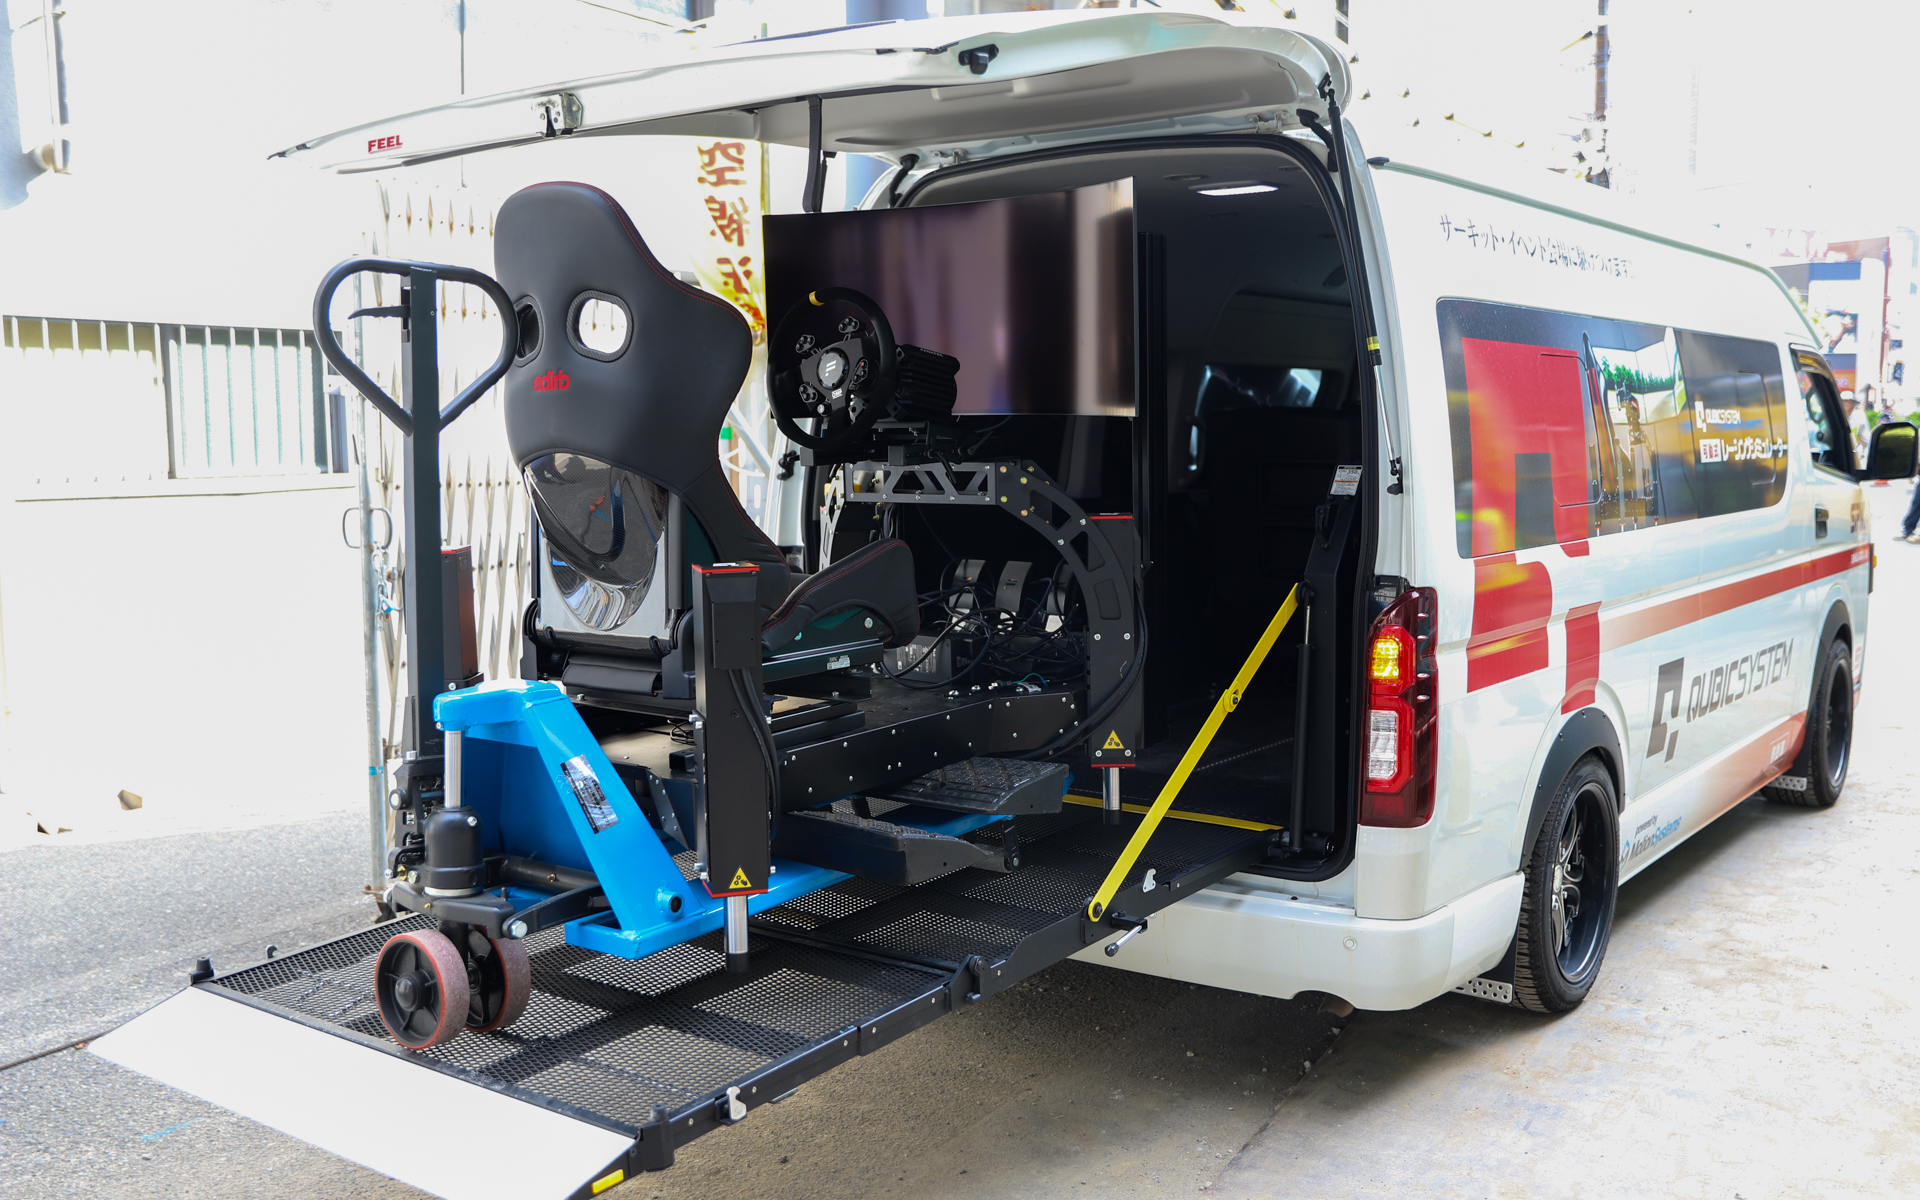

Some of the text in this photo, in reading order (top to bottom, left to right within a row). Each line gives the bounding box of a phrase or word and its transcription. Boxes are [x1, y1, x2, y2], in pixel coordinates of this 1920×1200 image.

[368, 135, 403, 153] FEEL
[533, 369, 571, 392] edirb
[1686, 637, 1795, 723] QUBICSYSTEM
